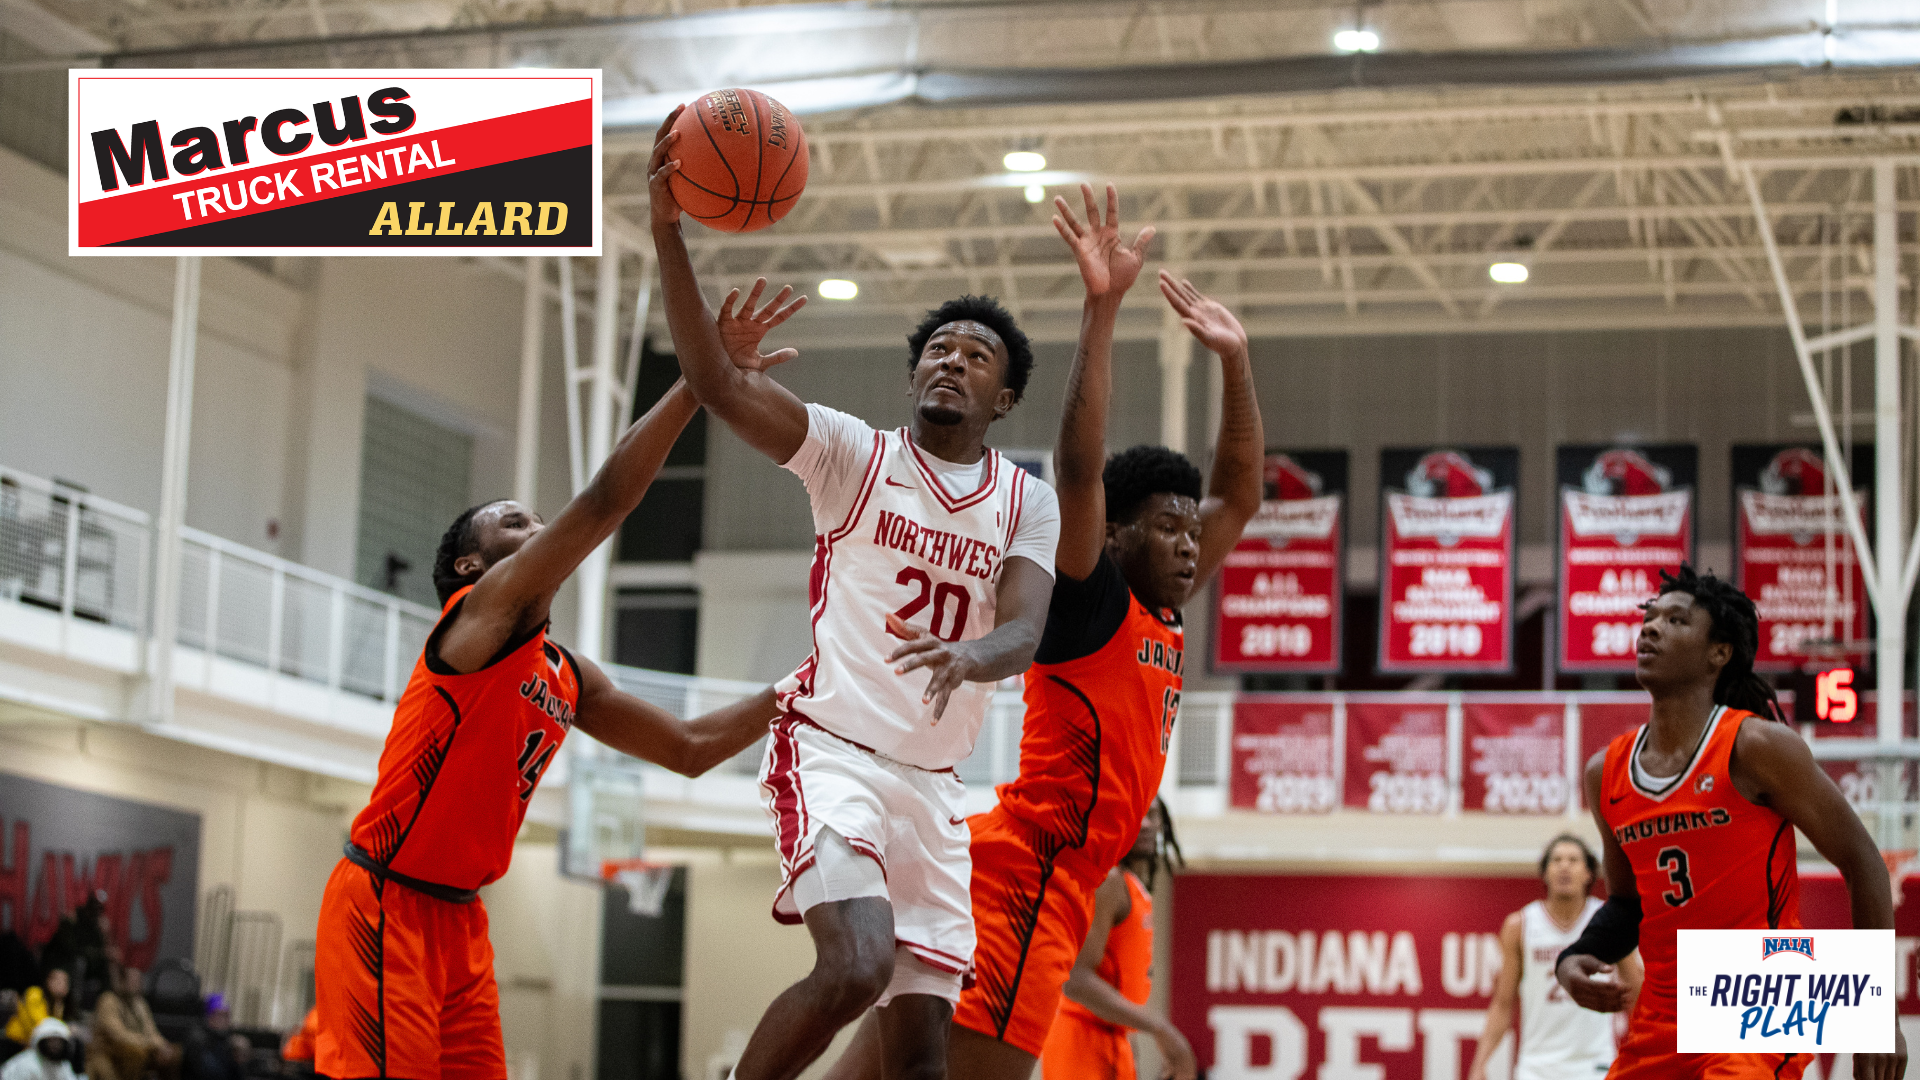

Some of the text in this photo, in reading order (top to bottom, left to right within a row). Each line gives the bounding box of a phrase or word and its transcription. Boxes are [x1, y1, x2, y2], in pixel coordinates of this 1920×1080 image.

[885, 565, 971, 643] 20
[1815, 667, 1858, 723] 15
[1657, 845, 1695, 908] 3
[1206, 930, 1502, 997] INDIANA UN
